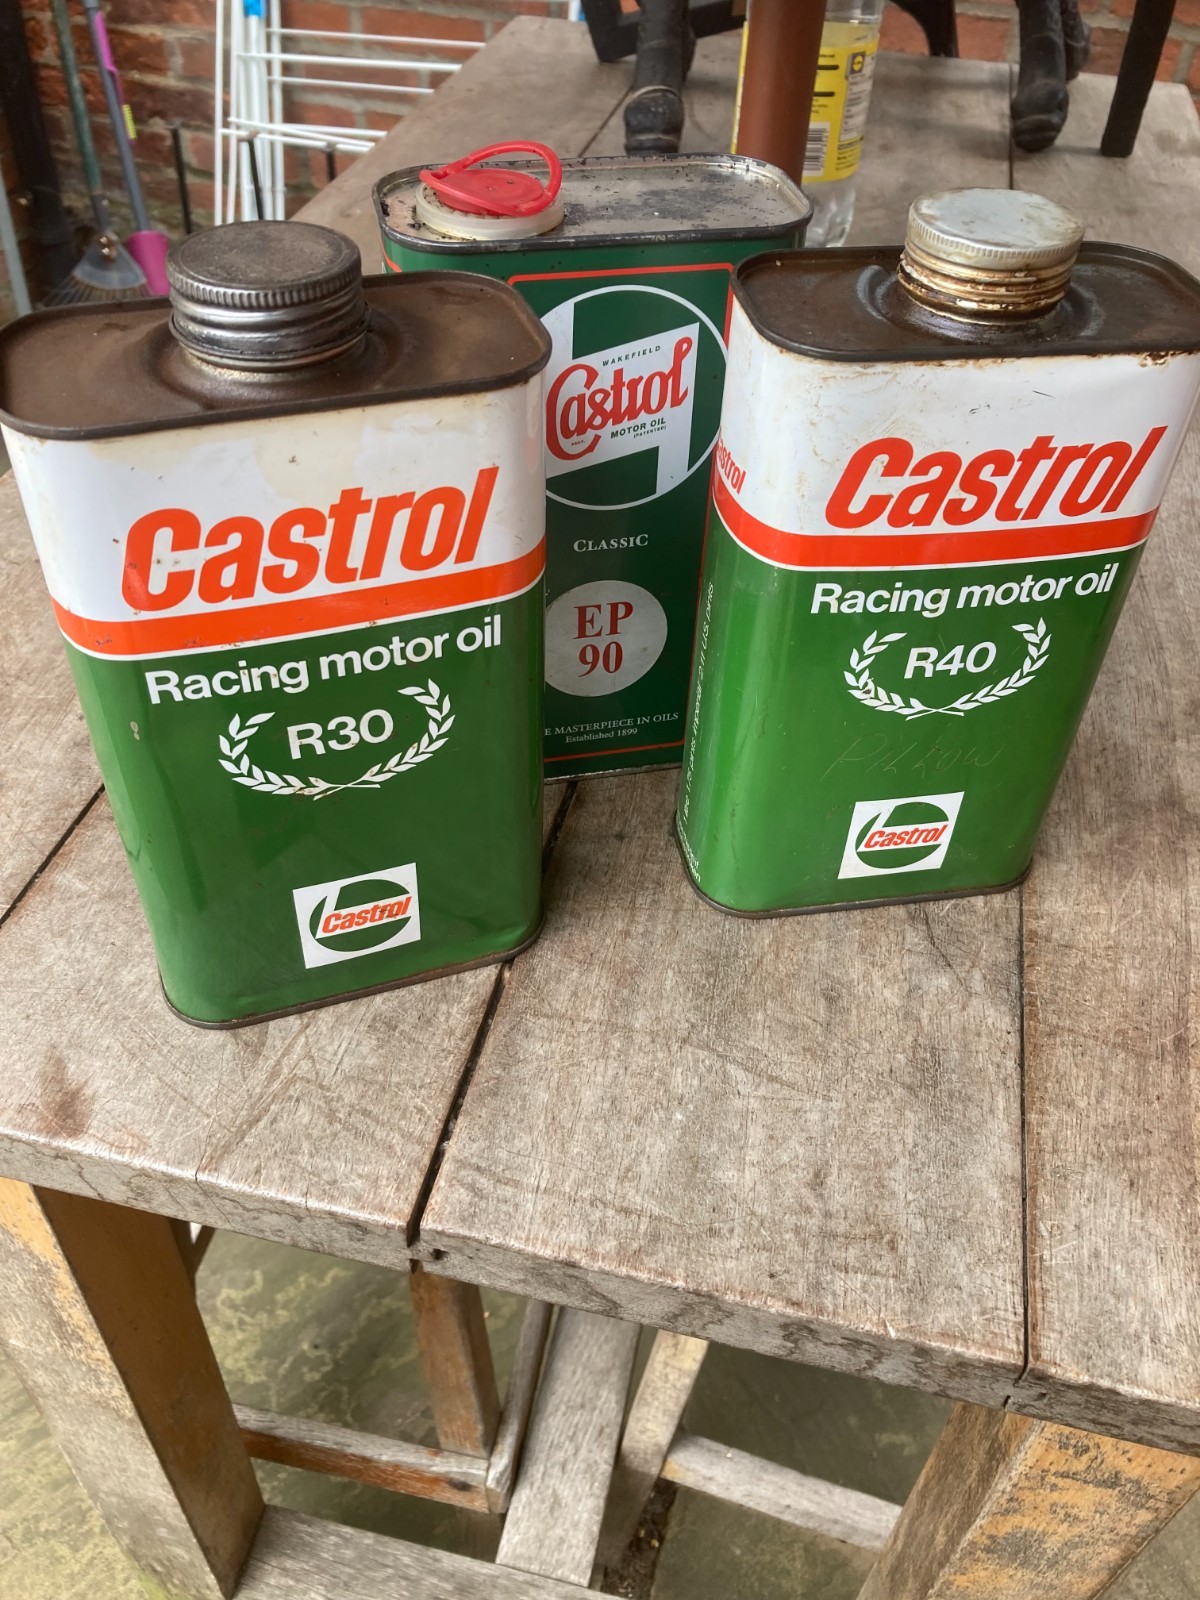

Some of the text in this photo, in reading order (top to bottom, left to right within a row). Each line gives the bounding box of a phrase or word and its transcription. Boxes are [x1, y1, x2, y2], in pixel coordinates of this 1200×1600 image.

[602, 345, 661, 367] WAKEFIELD
[546, 336, 693, 460] Castrol
[610, 417, 666, 439] MOTOR OIL
[824, 425, 1168, 529] Castrol
[122, 466, 500, 612] Castrol
[573, 534, 649, 552] CLASSIC
[705, 581, 714, 622] pints
[810, 563, 1119, 618] Racing motor oil
[573, 601, 634, 640] EP
[145, 614, 501, 705] Racing motor oil
[579, 641, 624, 678] 90
[903, 641, 997, 680] R40
[286, 708, 394, 760] R30
[555, 718, 634, 735] MASTERPIECE
[637, 715, 650, 725] IN
[653, 712, 679, 723] OILS
[565, 728, 638, 743] Established 1899
[864, 824, 948, 848] Castrol
[322, 896, 412, 934] Castrol
